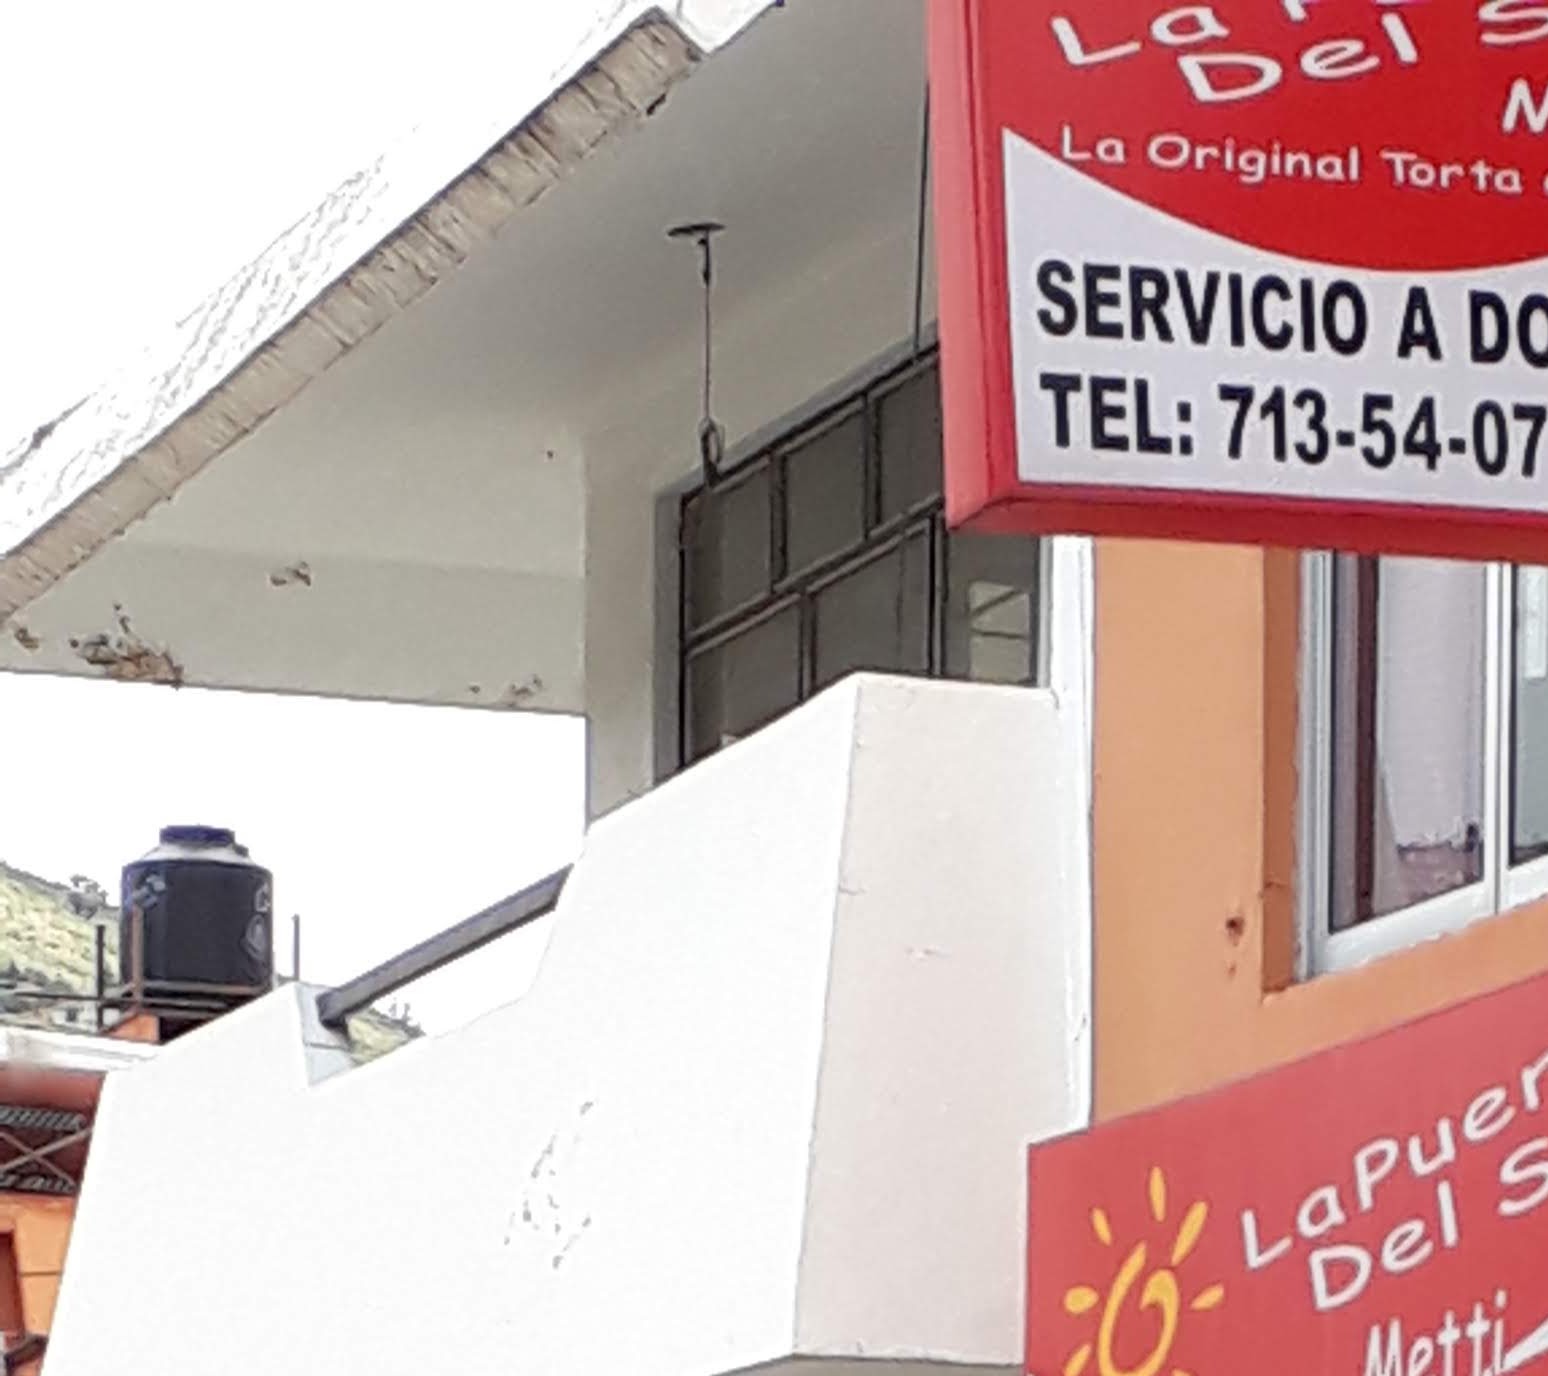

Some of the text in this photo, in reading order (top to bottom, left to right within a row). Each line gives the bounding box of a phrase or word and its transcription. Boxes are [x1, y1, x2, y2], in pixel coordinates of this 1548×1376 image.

[1051, 0, 1230, 66] La
[1177, 13, 1418, 102] Del
[1061, 124, 1127, 164] La
[1147, 133, 1360, 184] Original
[1379, 149, 1523, 195] Torta
[1035, 258, 1369, 358] SERVICIO
[1396, 285, 1443, 362] A
[1040, 372, 1194, 456] TEL:
[1308, 1178, 1460, 1313] Del
